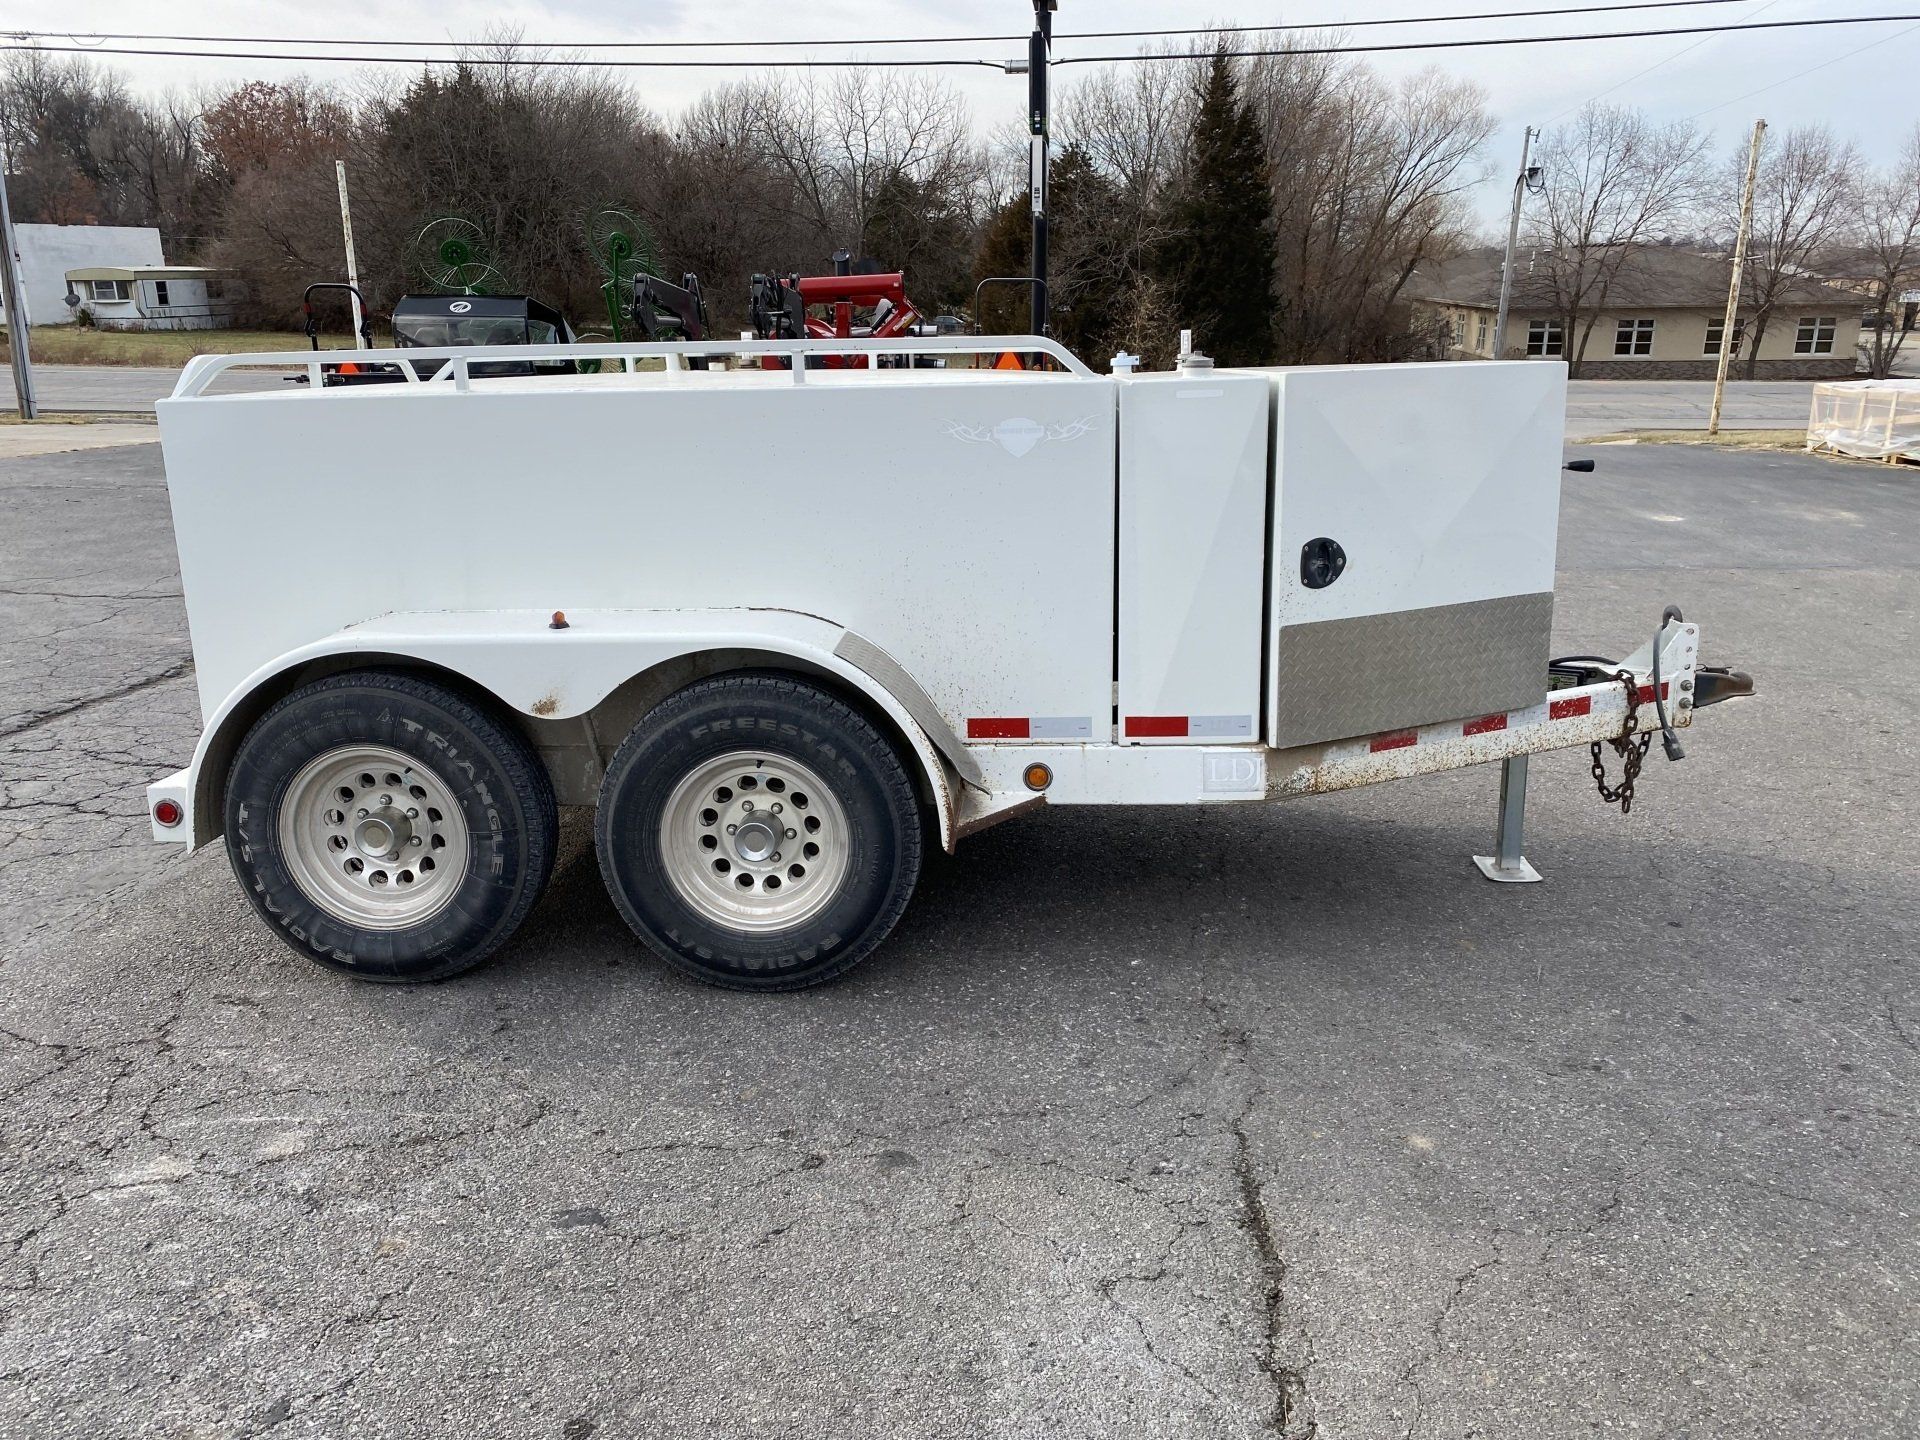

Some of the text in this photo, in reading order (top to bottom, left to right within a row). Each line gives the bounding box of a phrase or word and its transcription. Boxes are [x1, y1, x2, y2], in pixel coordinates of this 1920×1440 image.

[691, 716, 857, 778] FREESTAR
[1207, 757, 1264, 789] LDJ
[400, 716, 505, 876] TRIANGLE
[254, 873, 356, 965] RADIAL
[722, 932, 843, 970] RADIAL
